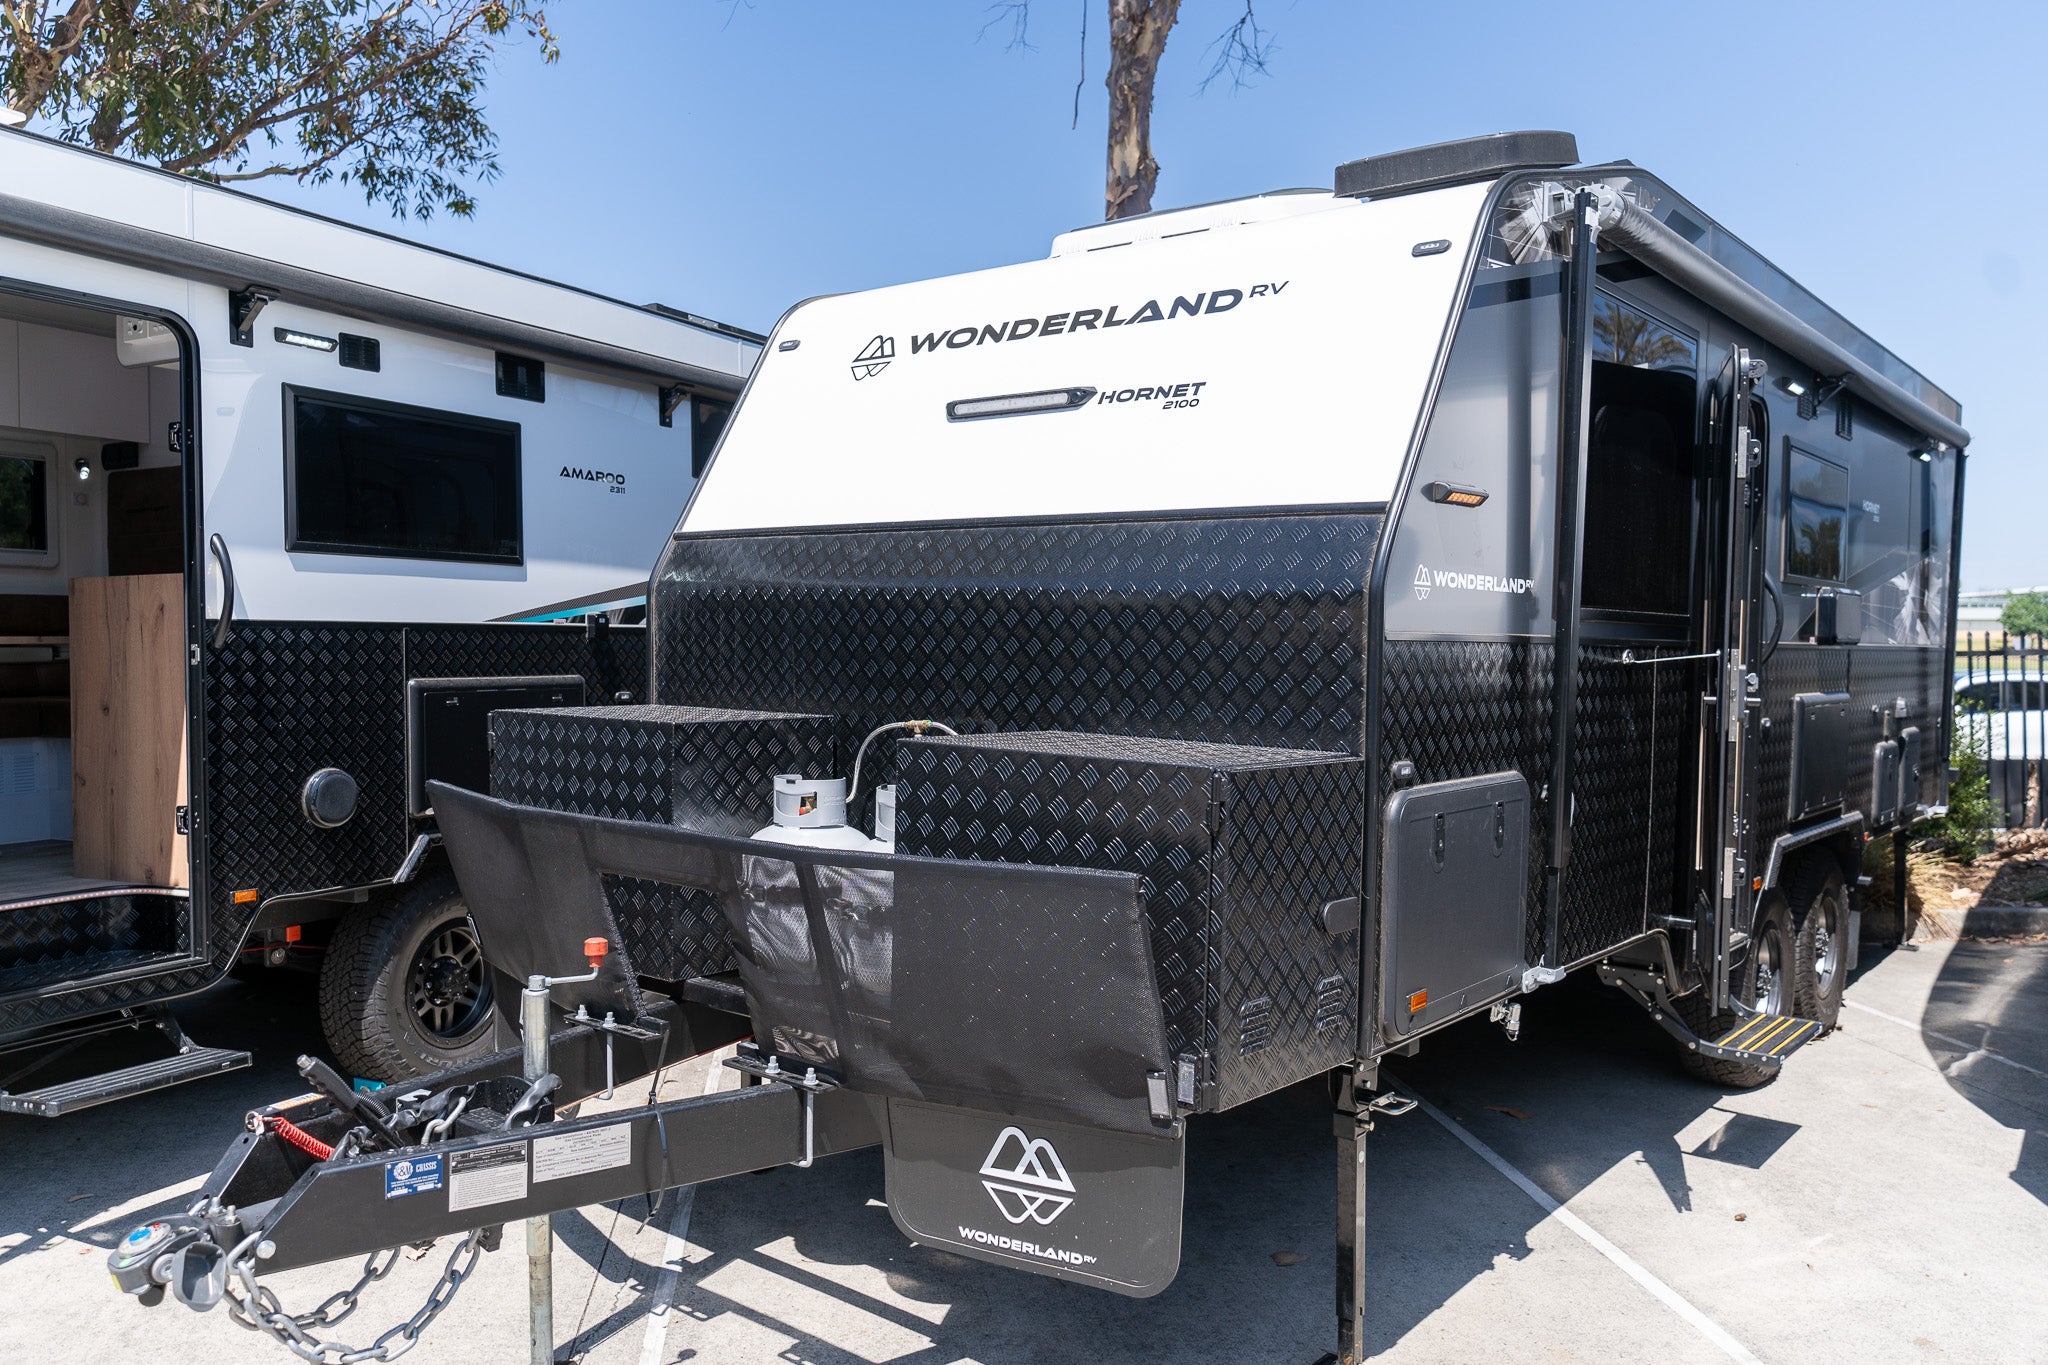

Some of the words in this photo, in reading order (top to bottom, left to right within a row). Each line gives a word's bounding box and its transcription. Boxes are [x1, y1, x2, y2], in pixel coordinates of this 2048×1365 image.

[910, 288, 1244, 355] WONDERLAND
[1248, 280, 1290, 299] RV
[1097, 381, 1207, 405] HORNET
[1162, 398, 1200, 410] 2100
[560, 466, 626, 485] AMAROO
[609, 485, 626, 495] 2311
[1433, 570, 1526, 594] WONDERLAND
[958, 1225, 1084, 1265] WONDERLAND
[1083, 1254, 1097, 1265] RV
